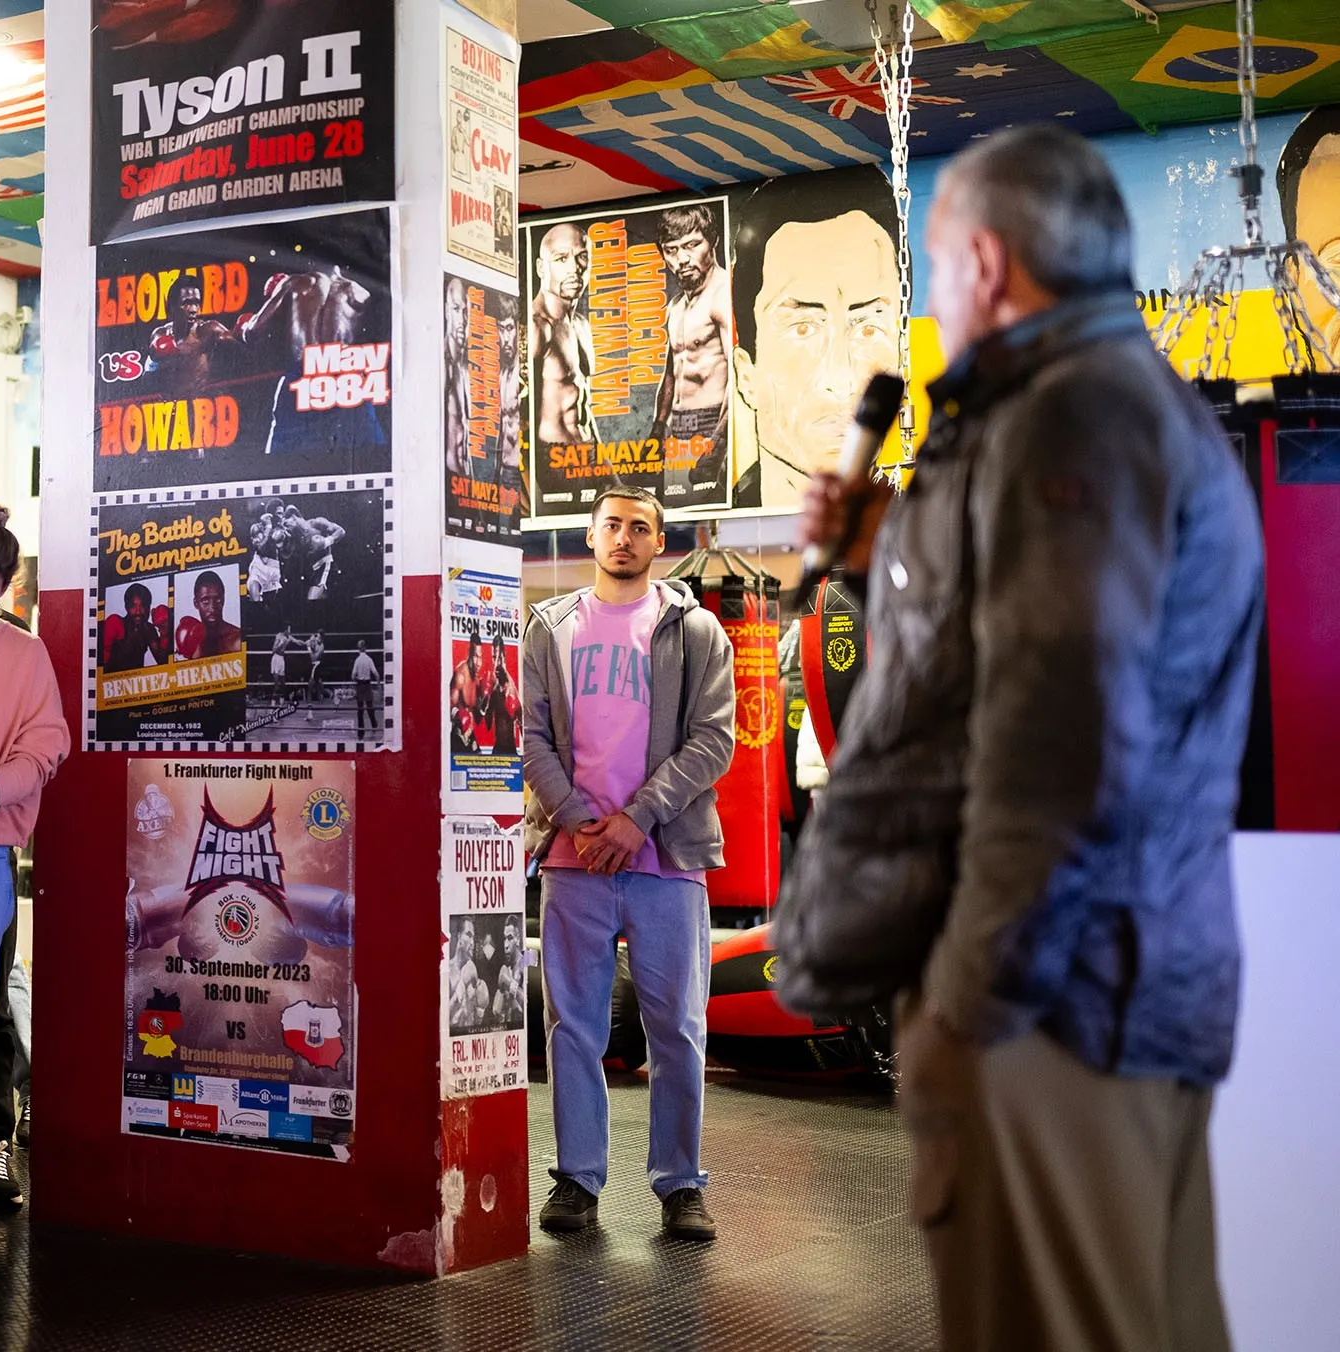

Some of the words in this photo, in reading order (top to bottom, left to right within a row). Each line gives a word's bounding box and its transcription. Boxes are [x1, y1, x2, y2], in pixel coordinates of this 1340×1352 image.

[461, 39, 502, 83] BOXING
[113, 54, 285, 139] Tyson
[300, 30, 362, 97] II
[120, 142, 154, 163] WBA
[158, 116, 245, 155] HEAVYWEIGHT
[248, 97, 365, 132] CHAMPIONSHIP
[120, 143, 237, 200] Saturday,
[245, 130, 316, 170] June
[323, 119, 365, 158] 28
[471, 128, 512, 176] CLAY
[133, 196, 165, 222] MGM
[168, 183, 217, 212] GRAND
[222, 174, 284, 202] GARDEN
[289, 166, 343, 191] ARENA
[588, 218, 630, 418] MAYWEATHER
[627, 242, 668, 387] PACQUIAO
[304, 342, 390, 377] May
[466, 286, 487, 460] MAYWEATHER
[288, 371, 391, 412] 1984
[98, 395, 240, 457] HOWARD
[549, 443, 594, 470] SAT
[566, 467, 593, 479] LIVE
[594, 466, 611, 477] ON
[611, 459, 698, 476] PAY-PER-VIEW
[99, 529, 142, 555] The
[142, 515, 206, 546] Battle
[208, 508, 233, 538] of
[115, 537, 248, 576] Champions
[479, 585, 493, 602] KO
[450, 615, 480, 634] TYSON
[486, 619, 519, 639] SPINKS
[152, 705, 178, 715] GOMEZ
[187, 699, 215, 709] PINTOR
[167, 731, 204, 739] Superdome
[177, 723, 184, 731] 3,
[163, 764, 172, 778] 1.
[174, 763, 243, 780] Frankfurter
[245, 764, 277, 780] Fight
[279, 764, 313, 781] Night
[310, 790, 342, 802] LIONS
[319, 804, 333, 824] L
[198, 819, 275, 854] FIGHT
[455, 839, 514, 872] HOLYFIELD
[189, 852, 285, 886] NIGHT
[218, 894, 234, 907] BOX
[241, 895, 257, 911] Club
[466, 876, 505, 910] TYSON
[164, 956, 187, 975] 30.
[189, 958, 270, 981] September
[272, 964, 311, 982] 2023
[202, 983, 243, 1002] 18:00
[244, 985, 271, 1005] Uhr
[226, 1020, 246, 1040] VS
[180, 1046, 294, 1070] Brandenburghalle
[471, 1038, 490, 1061] NOV.
[240, 1091, 260, 1099] Allianz
[293, 1096, 327, 1107] Frankfurter
[182, 1112, 208, 1121] Sparkasse
[182, 1119, 212, 1128] Oder-Spree
[235, 1119, 267, 1128] APOTHEKEN
